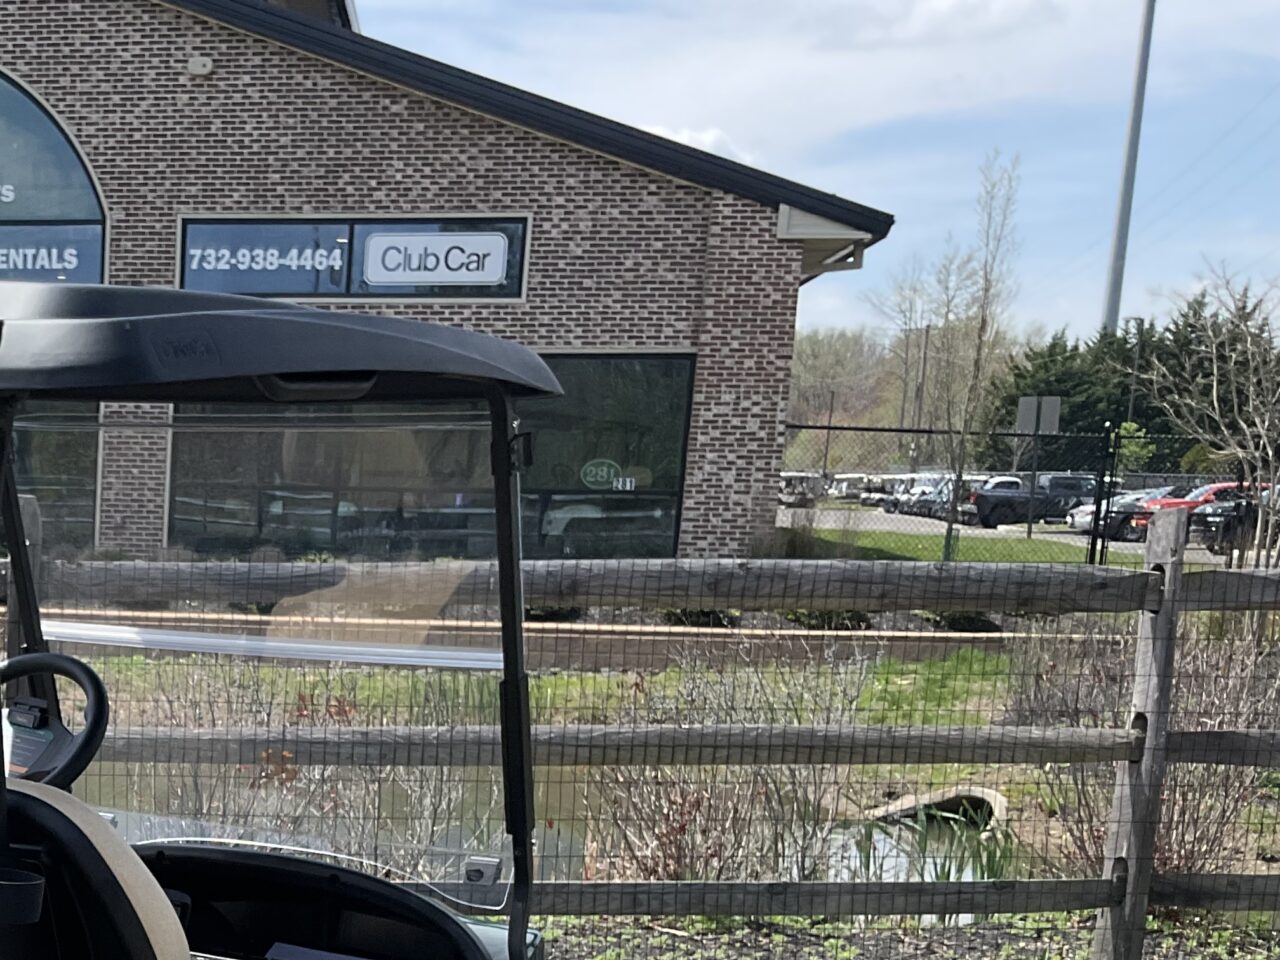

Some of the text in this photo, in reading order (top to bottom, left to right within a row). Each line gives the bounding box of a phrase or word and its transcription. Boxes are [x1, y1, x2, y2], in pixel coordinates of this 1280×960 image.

[188, 248, 343, 271] 732-938-4464
[380, 245, 492, 273] Club Car
[585, 465, 616, 482] 281
